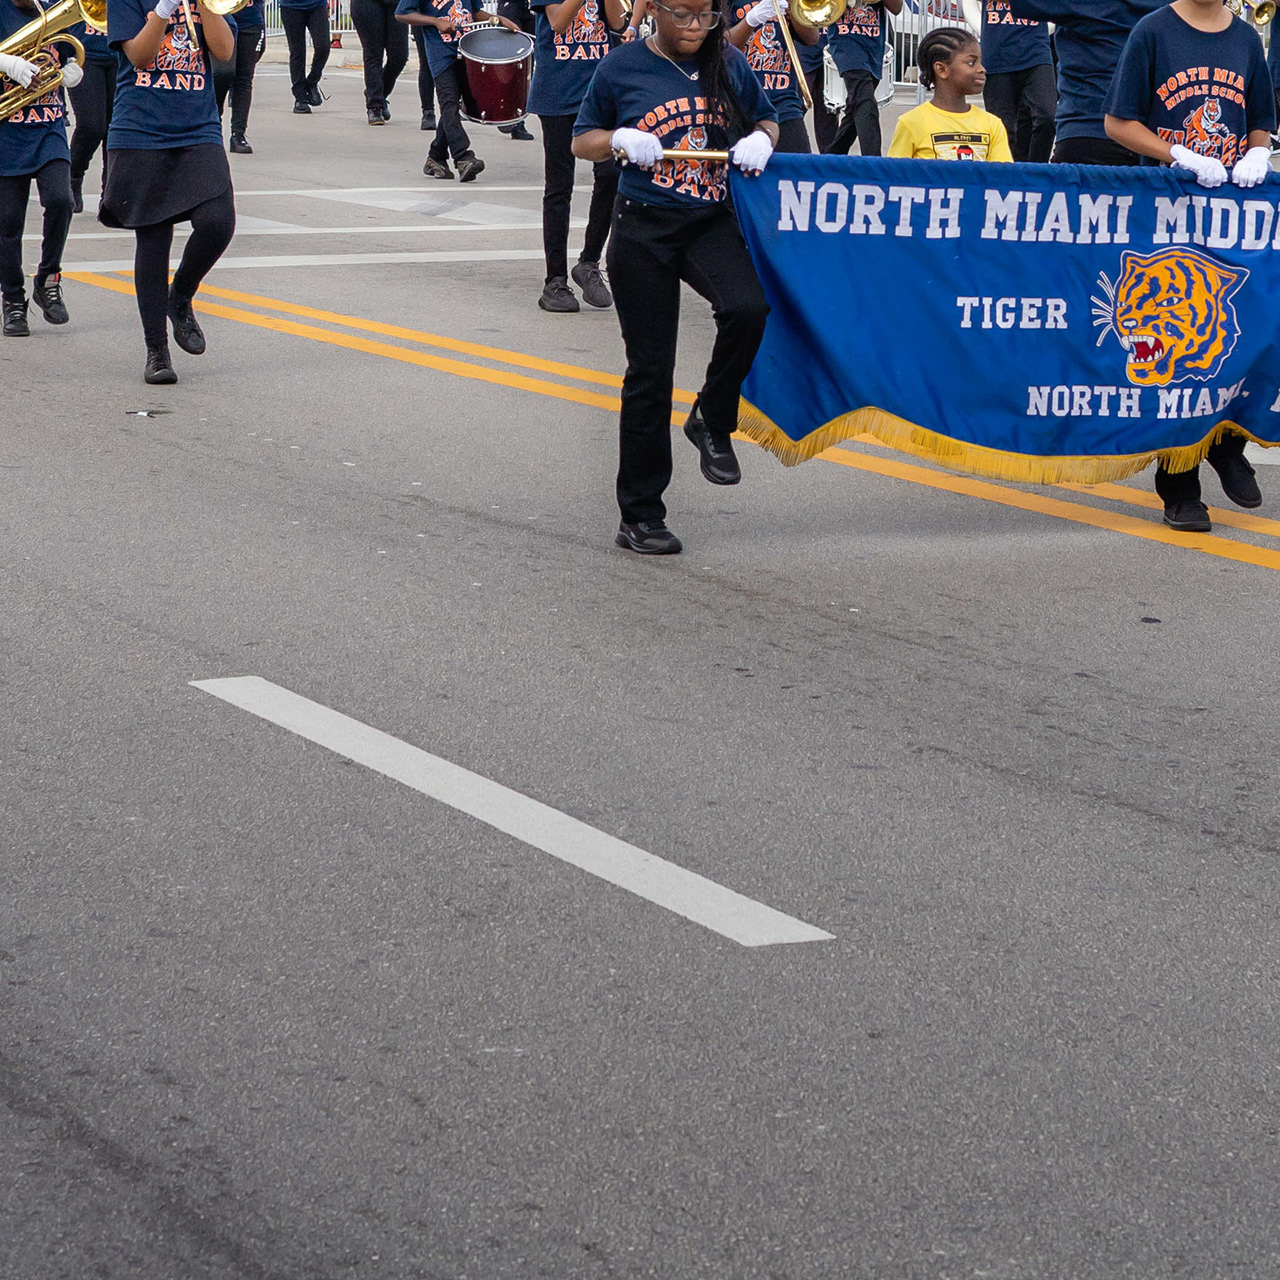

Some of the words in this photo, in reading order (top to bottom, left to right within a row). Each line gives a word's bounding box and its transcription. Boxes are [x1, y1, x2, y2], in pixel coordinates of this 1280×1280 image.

[441, 30, 463, 43] BA
[838, 24, 881, 37] BAND
[135, 72, 206, 91] BAND
[763, 73, 790, 90] ND
[1156, 66, 1209, 101] NORTH
[1213, 67, 1245, 91] MIA
[1164, 84, 1209, 111] MIDDLE
[1211, 85, 1246, 110] SCHO
[9, 106, 63, 124] BAN
[636, 97, 690, 132] NORTH
[651, 173, 726, 202] BAN
[777, 178, 964, 239] NORTH
[980, 188, 1134, 244] MIAMI
[956, 296, 1068, 329] TIGER
[1026, 384, 1141, 418] NORTH
